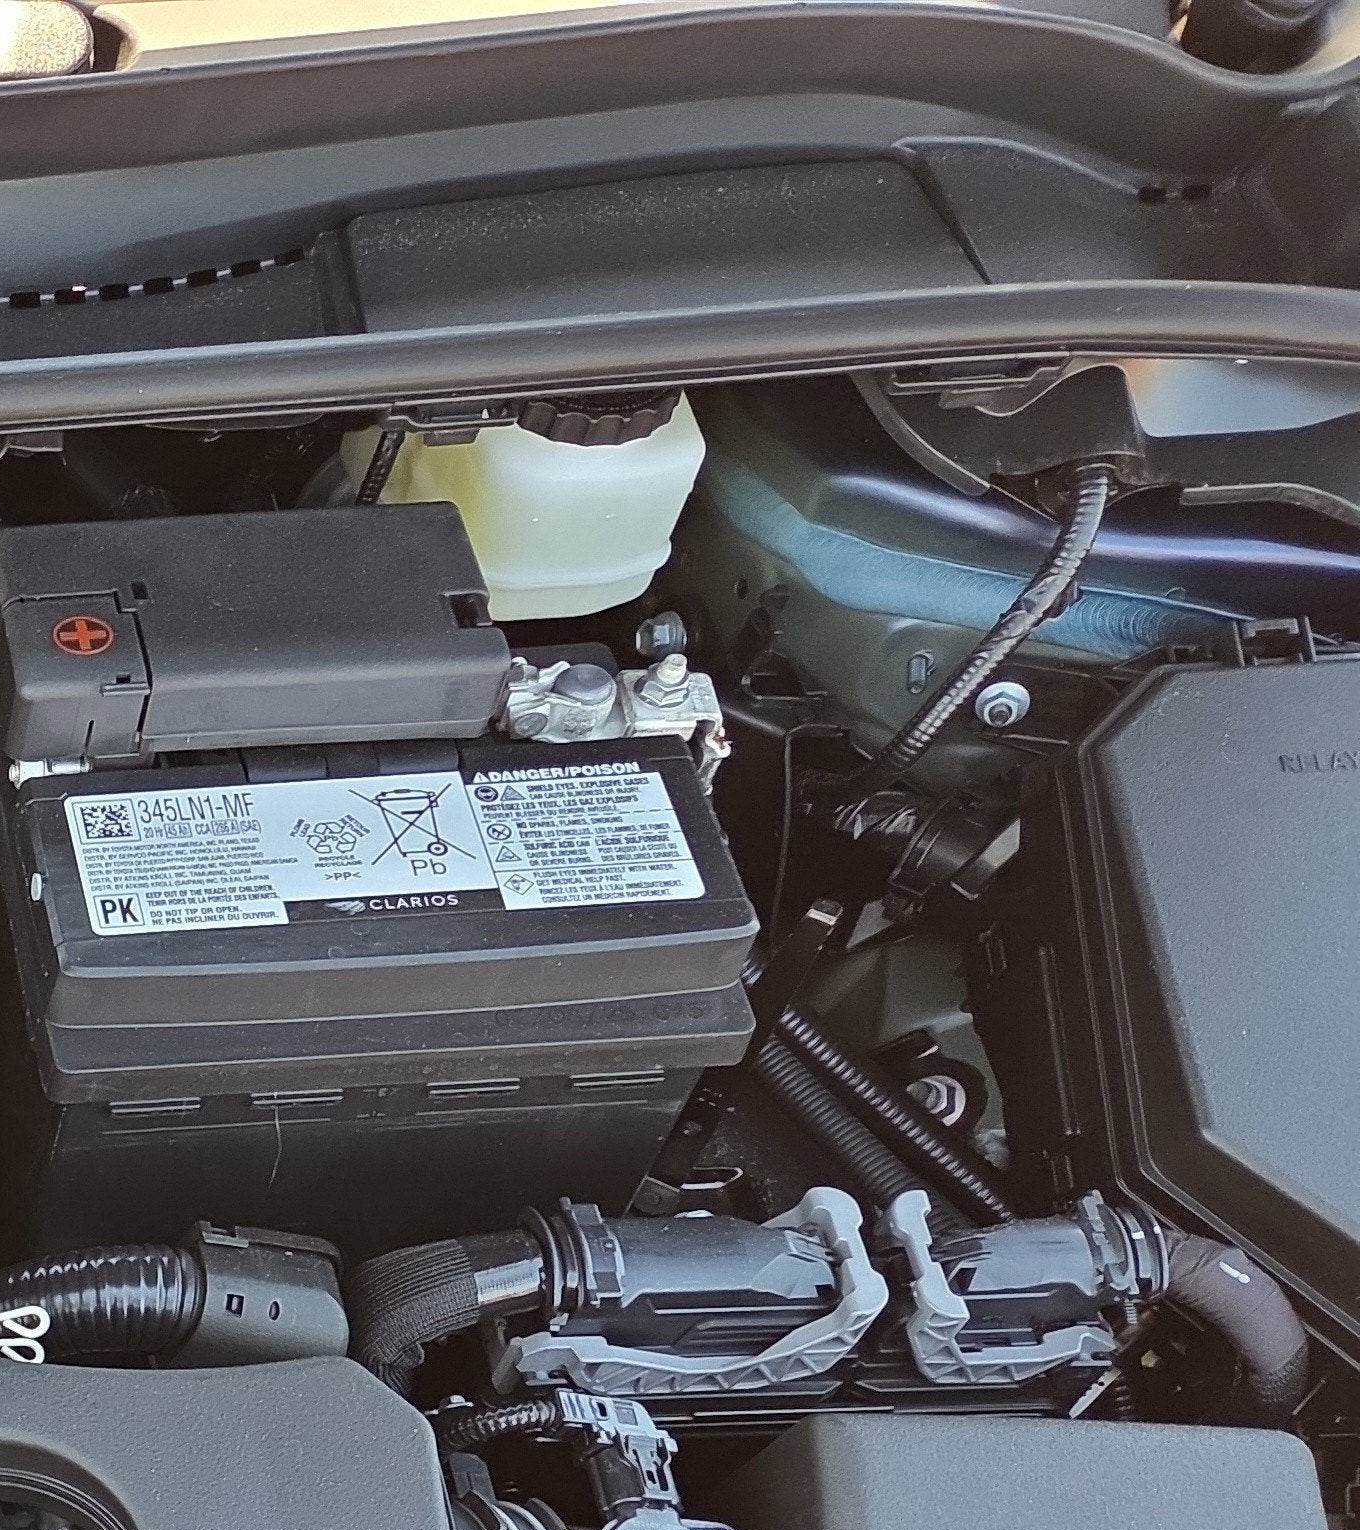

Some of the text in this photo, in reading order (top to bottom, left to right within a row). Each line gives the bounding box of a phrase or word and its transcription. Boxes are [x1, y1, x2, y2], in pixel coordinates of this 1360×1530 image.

[487, 761, 640, 782] DANGER/POISON
[137, 791, 255, 824] 345LN1-MF
[410, 857, 446, 876] Pb
[100, 897, 139, 925] PK
[150, 910, 163, 918] DO
[165, 909, 182, 917] NOT
[216, 905, 242, 913] OPEN.
[369, 893, 459, 911] CLARIOS
[152, 910, 279, 926] NE PAS INCLINER OU OUVRIR.
